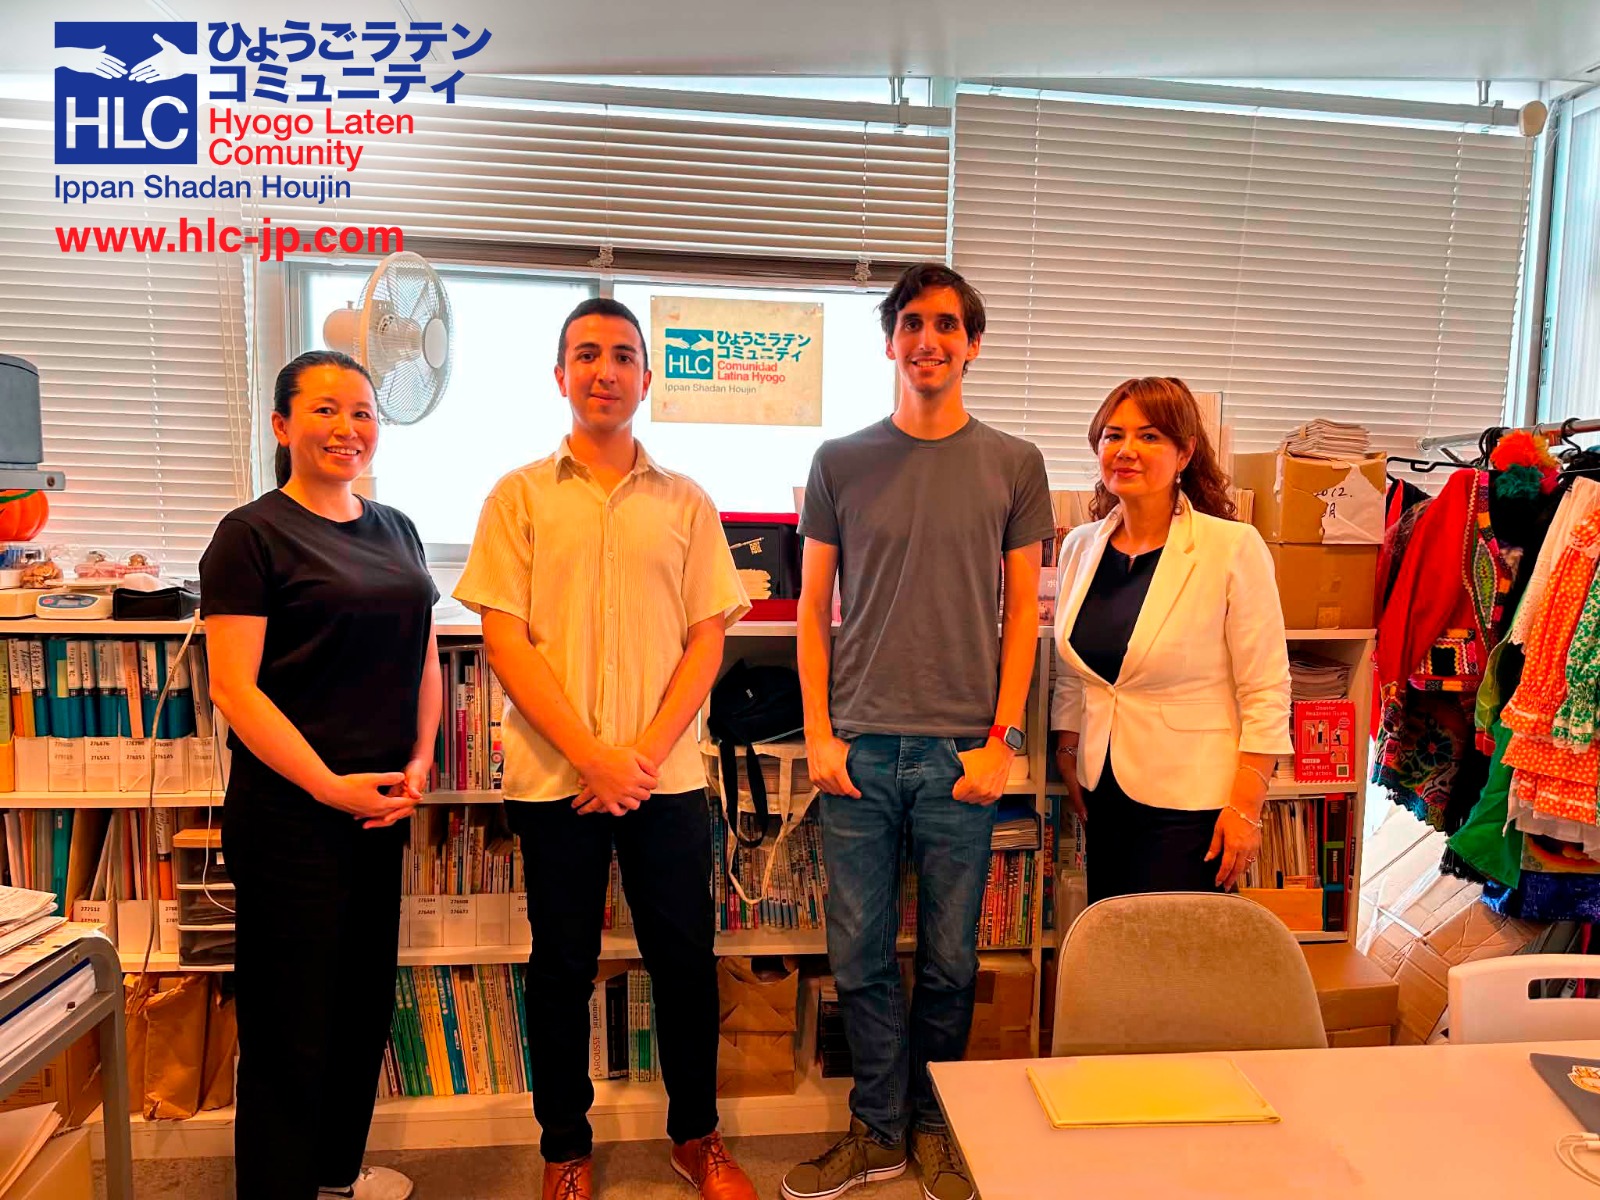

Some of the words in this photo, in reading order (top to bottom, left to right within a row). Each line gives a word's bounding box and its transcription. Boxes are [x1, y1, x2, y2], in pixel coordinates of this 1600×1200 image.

[717, 330, 811, 348] ひょうごラテン
[717, 346, 803, 362] コミュニティ
[669, 354, 711, 375] HLC
[717, 361, 778, 373] Comunidad
[717, 372, 749, 382] Latina
[752, 372, 786, 384] Hyogo
[665, 383, 690, 392] Ippan
[693, 384, 726, 394] Shadan
[729, 385, 757, 395] Houjin
